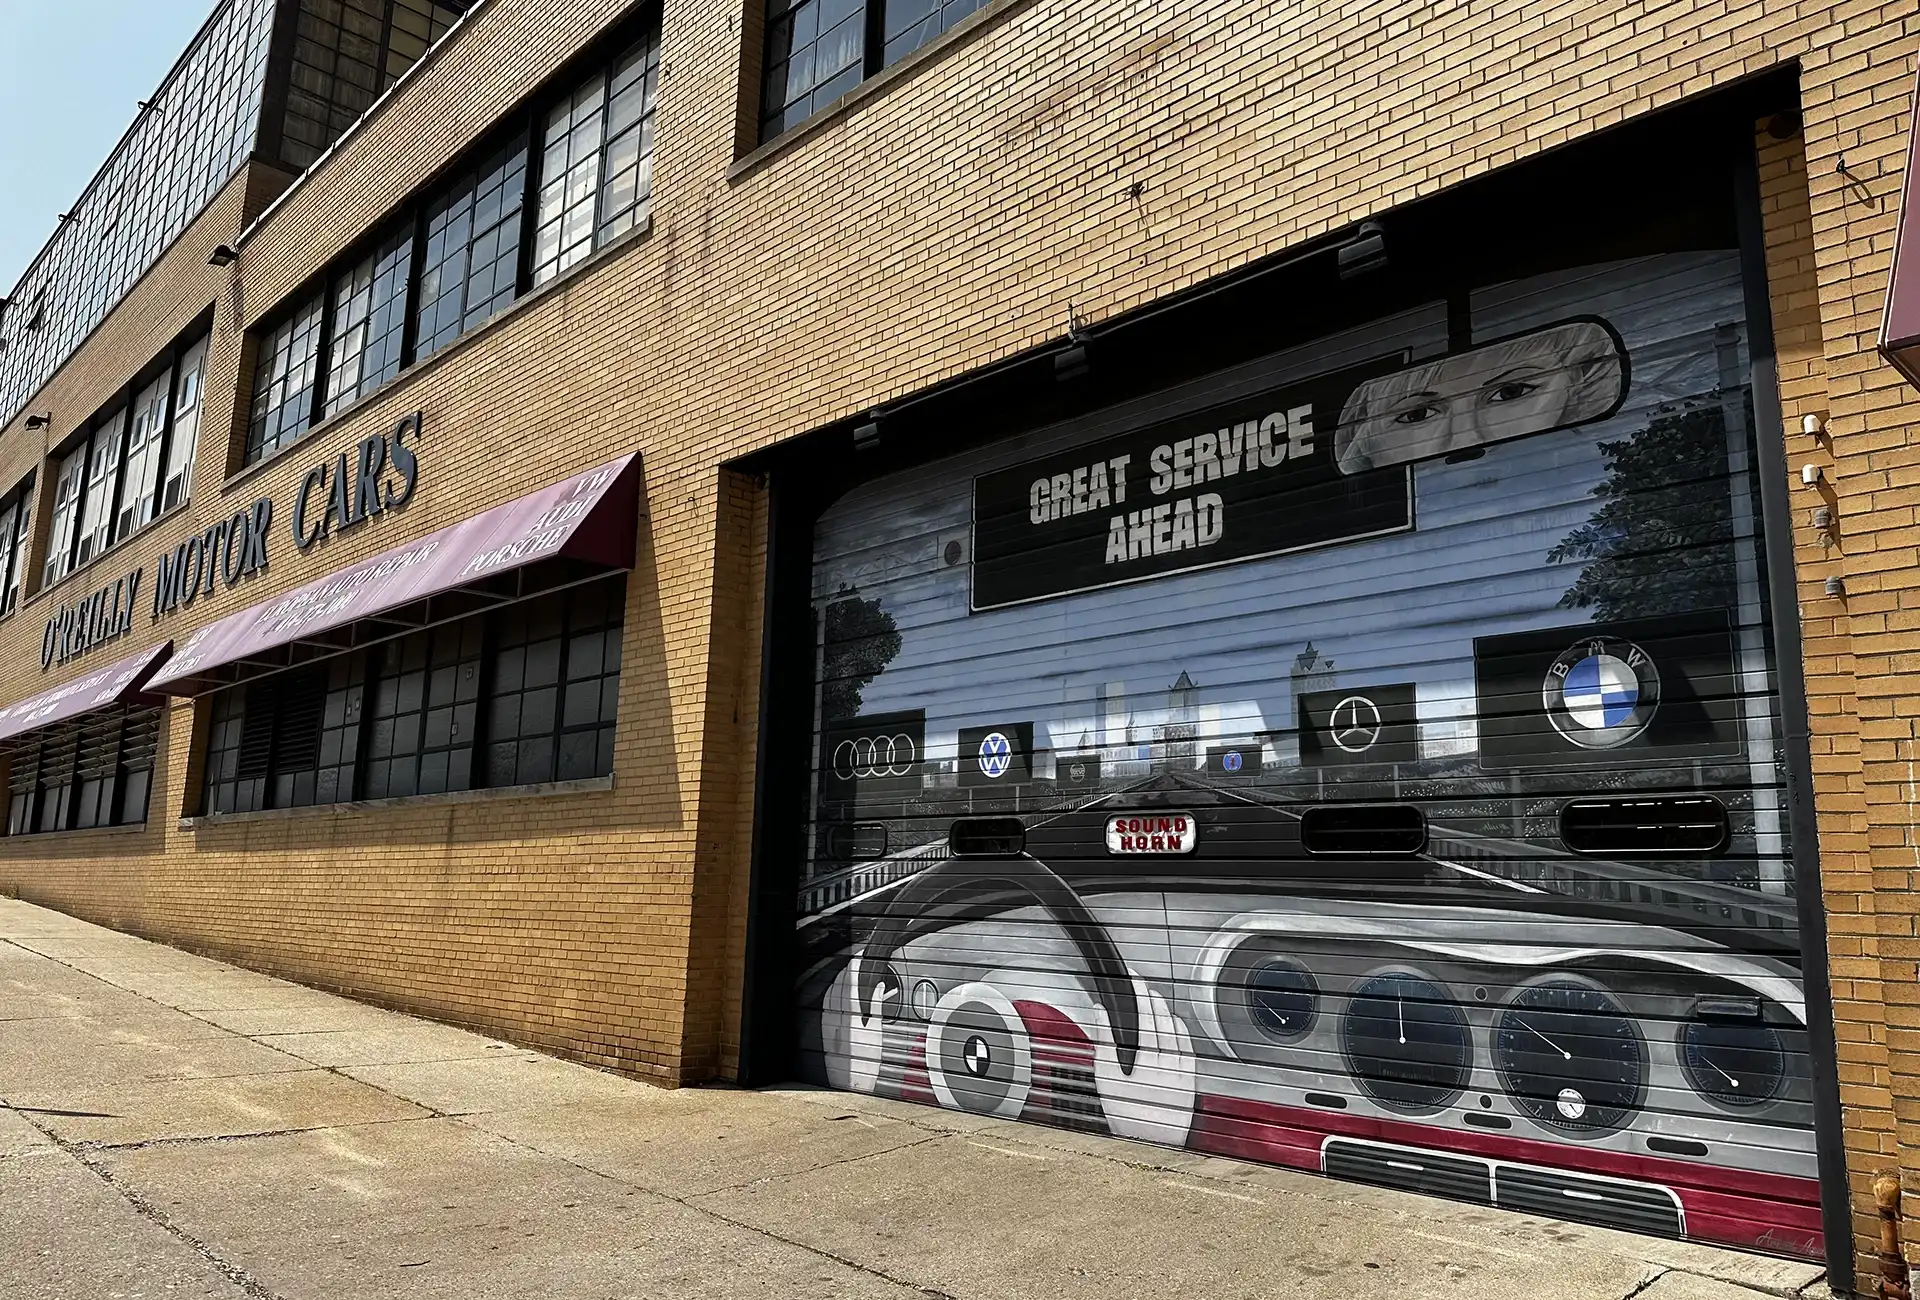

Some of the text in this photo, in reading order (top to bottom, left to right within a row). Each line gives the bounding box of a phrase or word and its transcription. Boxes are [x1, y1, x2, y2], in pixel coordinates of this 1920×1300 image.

[572, 466, 618, 498] VW
[1030, 403, 1314, 525] GREAT SERVICE
[527, 494, 596, 534] AUDI
[1105, 493, 1224, 564] AHEAD
[40, 412, 423, 670] O'REILLY MOTOR CARS
[462, 523, 571, 576] PORSCHE
[328, 564, 377, 595] AUTO
[369, 541, 440, 581] REPAIR
[1115, 817, 1187, 834] SOUND
[1120, 835, 1181, 850] HORN
